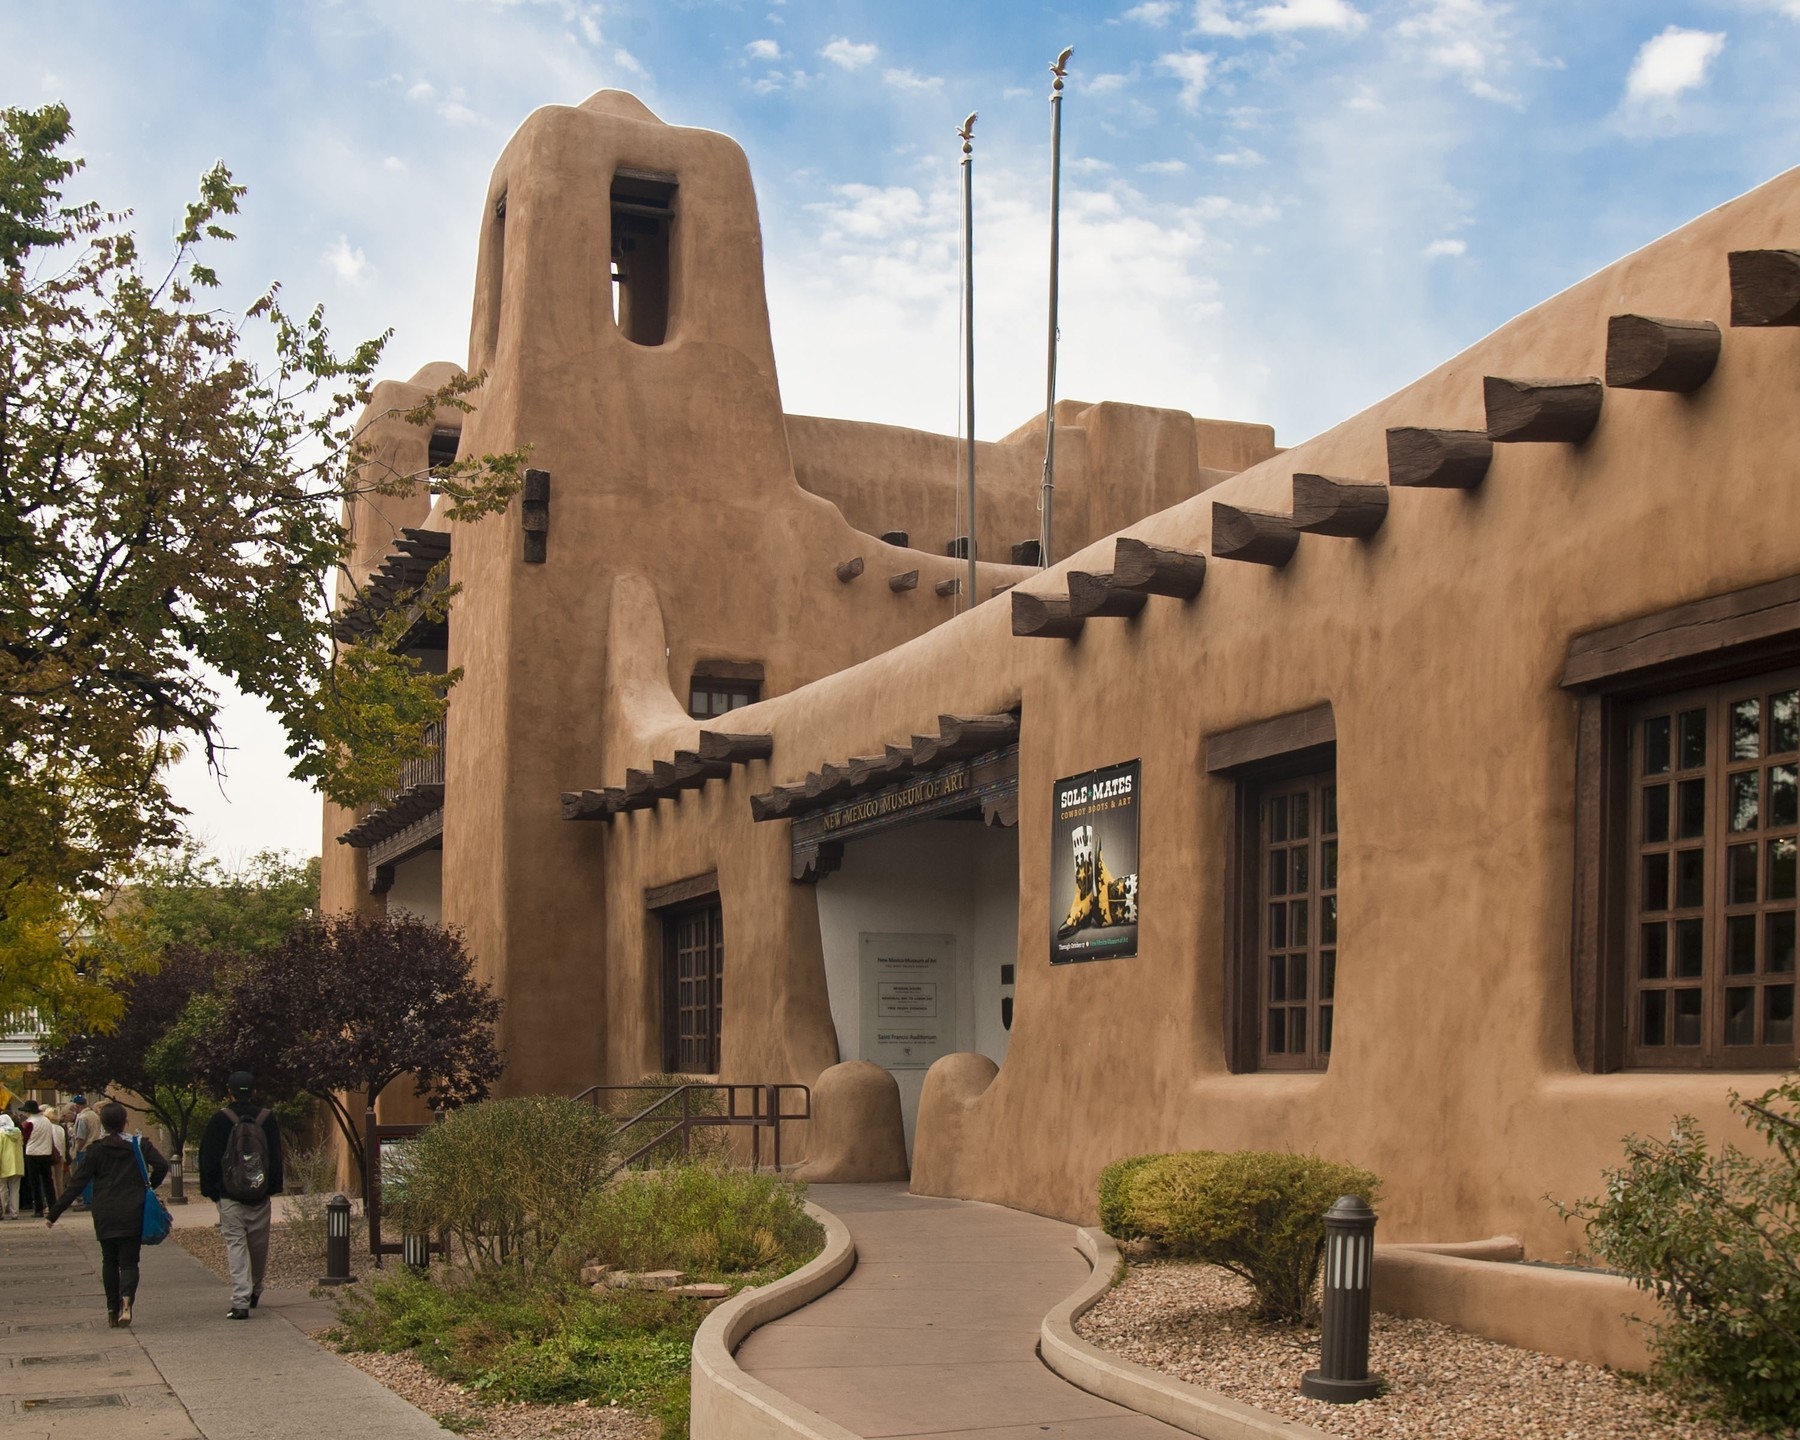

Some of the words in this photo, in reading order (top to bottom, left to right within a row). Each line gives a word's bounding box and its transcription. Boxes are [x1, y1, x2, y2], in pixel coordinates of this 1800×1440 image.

[824, 812, 844, 829] NEW
[845, 800, 878, 823] MEXICO
[883, 787, 923, 811] MUSEUM
[926, 781, 941, 798] OF
[944, 772, 964, 793] ART
[1061, 786, 1087, 808] SOLE
[1093, 775, 1132, 800] MATES
[1061, 807, 1086, 820] COWBOY
[1088, 802, 1108, 814] BOOTS
[1110, 800, 1116, 808] &
[1118, 797, 1132, 807] ART
